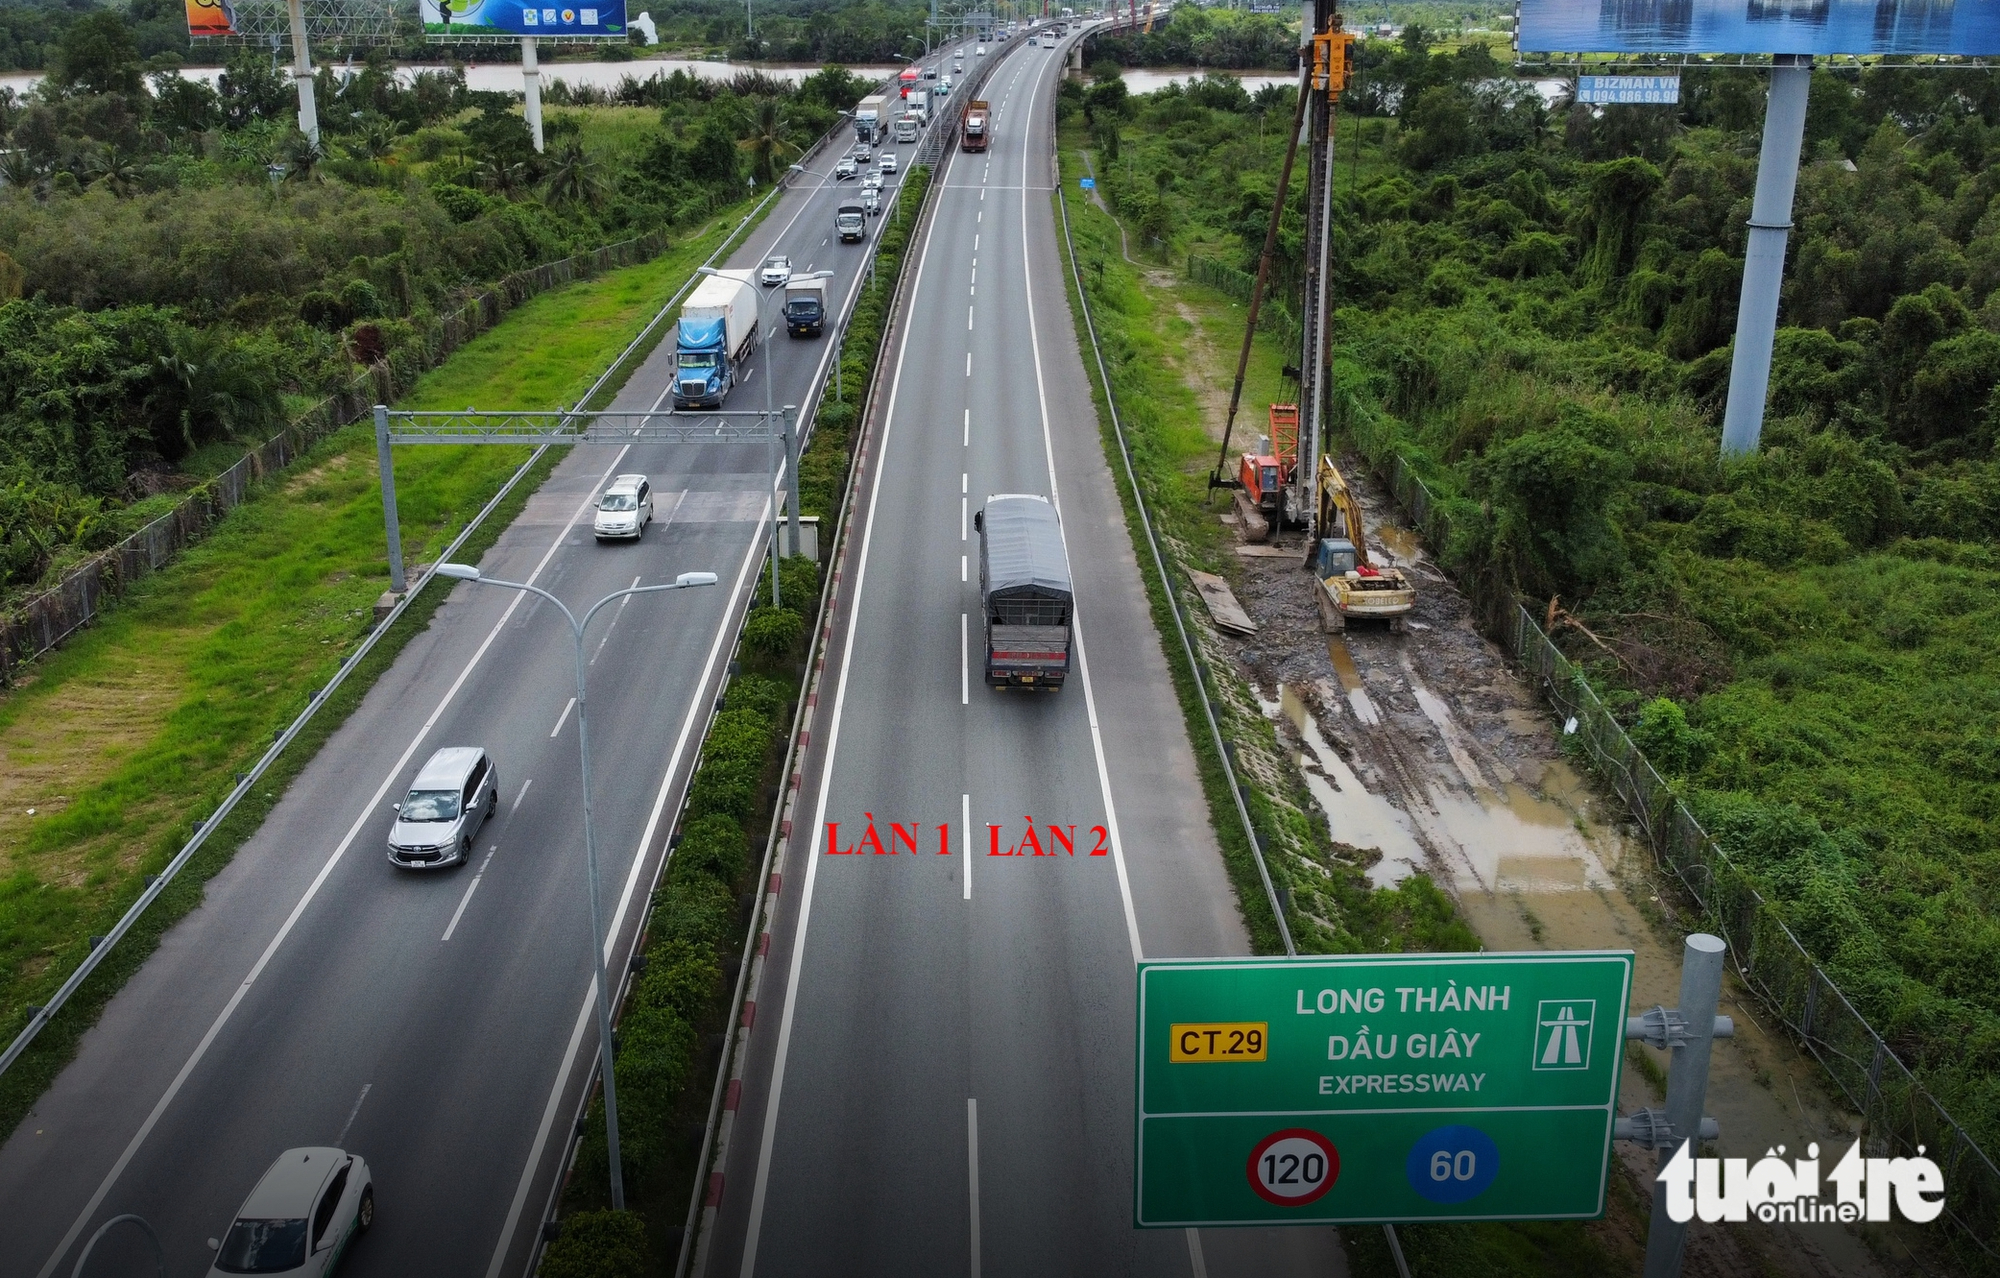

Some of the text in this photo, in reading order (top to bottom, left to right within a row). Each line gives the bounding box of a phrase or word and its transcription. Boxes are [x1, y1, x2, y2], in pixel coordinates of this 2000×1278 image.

[1593, 90, 1679, 102] 094.986.98.98
[1594, 78, 1680, 89] BIZMAN.VN
[1296, 980, 1510, 1014] LONG THÀNH
[1180, 1030, 1262, 1055] CT.29
[1327, 1025, 1481, 1061] DẦU GIÂY
[1318, 1073, 1486, 1095] EXPRESSWAY
[1263, 1153, 1324, 1185] 120
[1430, 1150, 1476, 1182] 60
